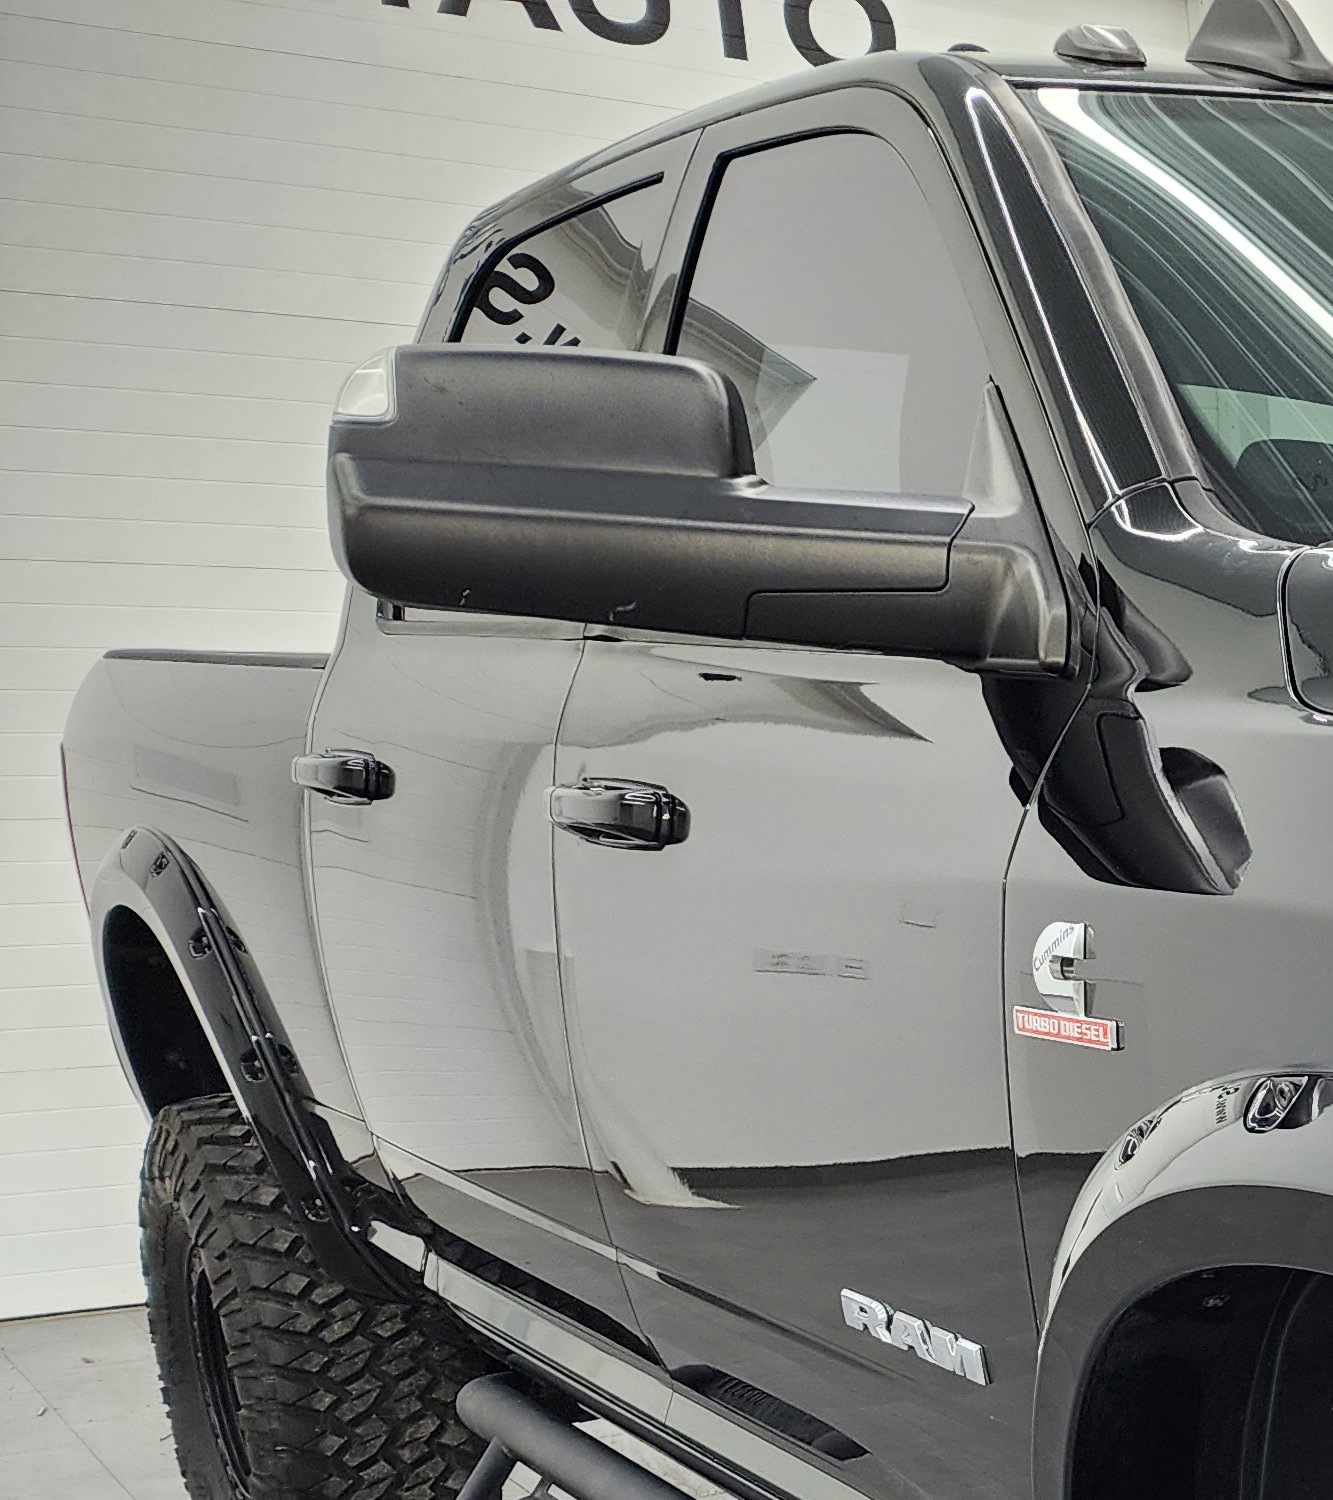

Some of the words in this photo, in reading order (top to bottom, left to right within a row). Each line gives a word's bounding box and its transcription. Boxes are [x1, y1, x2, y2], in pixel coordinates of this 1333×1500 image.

[1033, 925, 1076, 972] Cummins
[1016, 1011, 1059, 1034] TURBO
[1061, 1019, 1110, 1043] DIESEL
[840, 1287, 992, 1387] RAM
